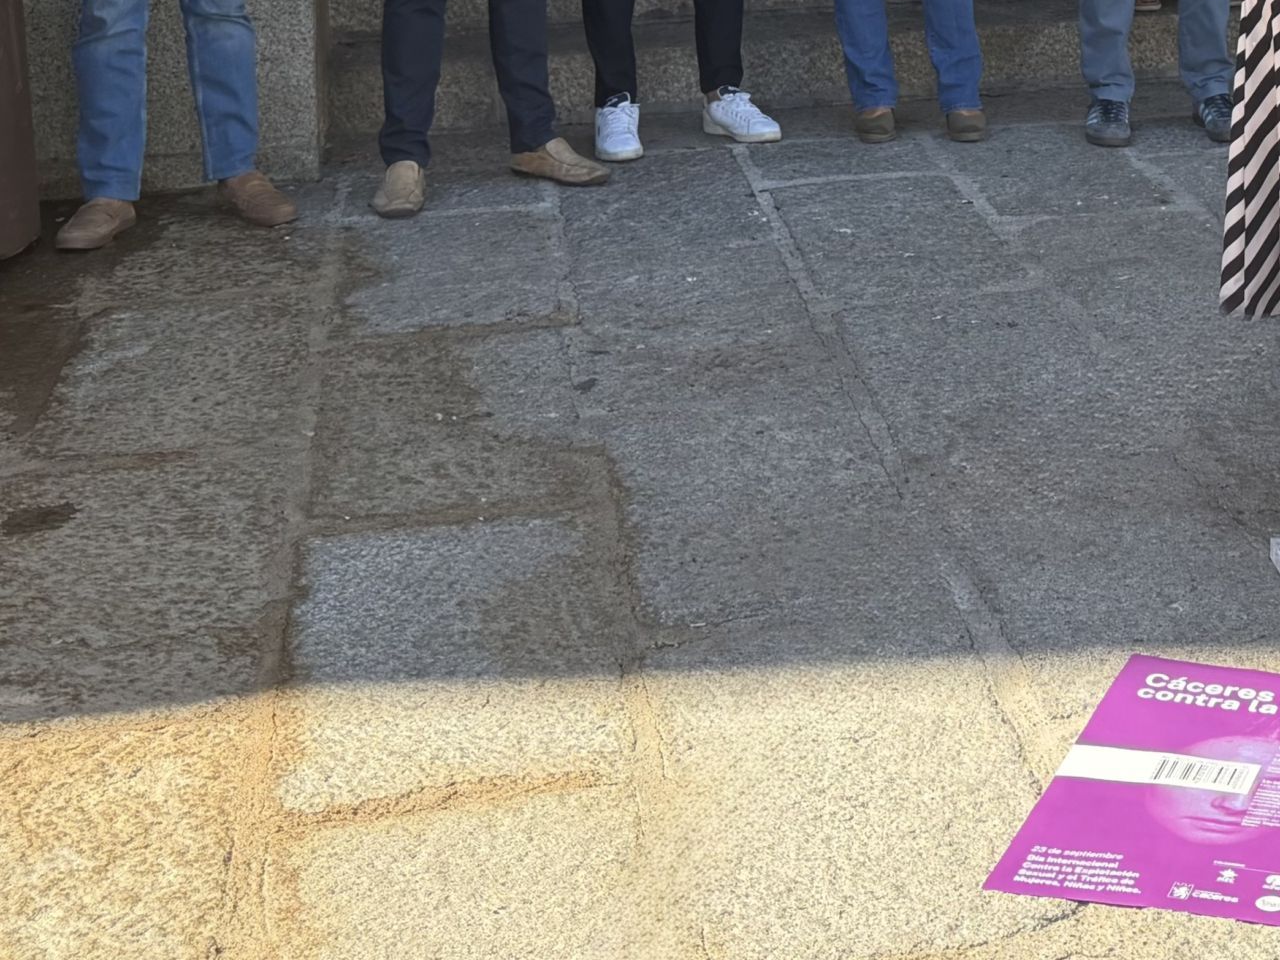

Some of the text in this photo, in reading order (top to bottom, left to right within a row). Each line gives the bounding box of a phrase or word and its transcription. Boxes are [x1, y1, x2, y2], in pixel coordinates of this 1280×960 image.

[1137, 687, 1241, 712] contra
[1248, 699, 1278, 715] la
[1145, 673, 1276, 703] Cáceres
